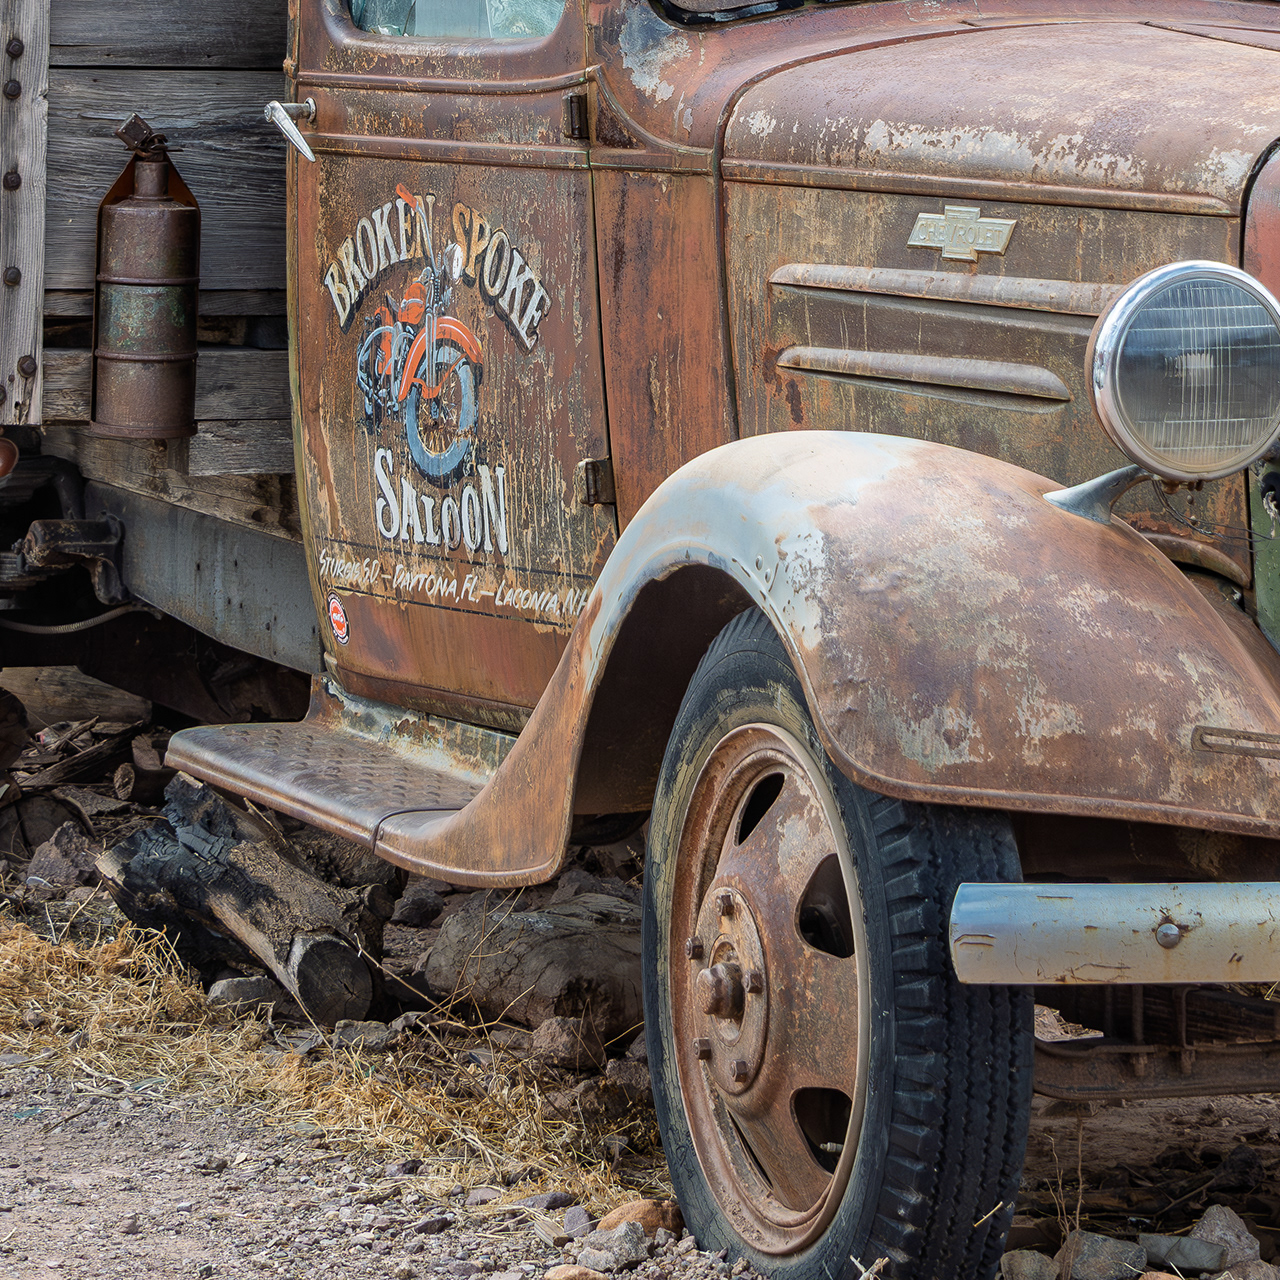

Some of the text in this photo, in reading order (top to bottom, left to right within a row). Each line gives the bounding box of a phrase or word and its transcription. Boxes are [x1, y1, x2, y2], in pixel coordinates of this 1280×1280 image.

[324, 194, 552, 351] BROKEN SPOKE
[918, 220, 1005, 246] CHEVROLET
[374, 448, 509, 556] SALOON
